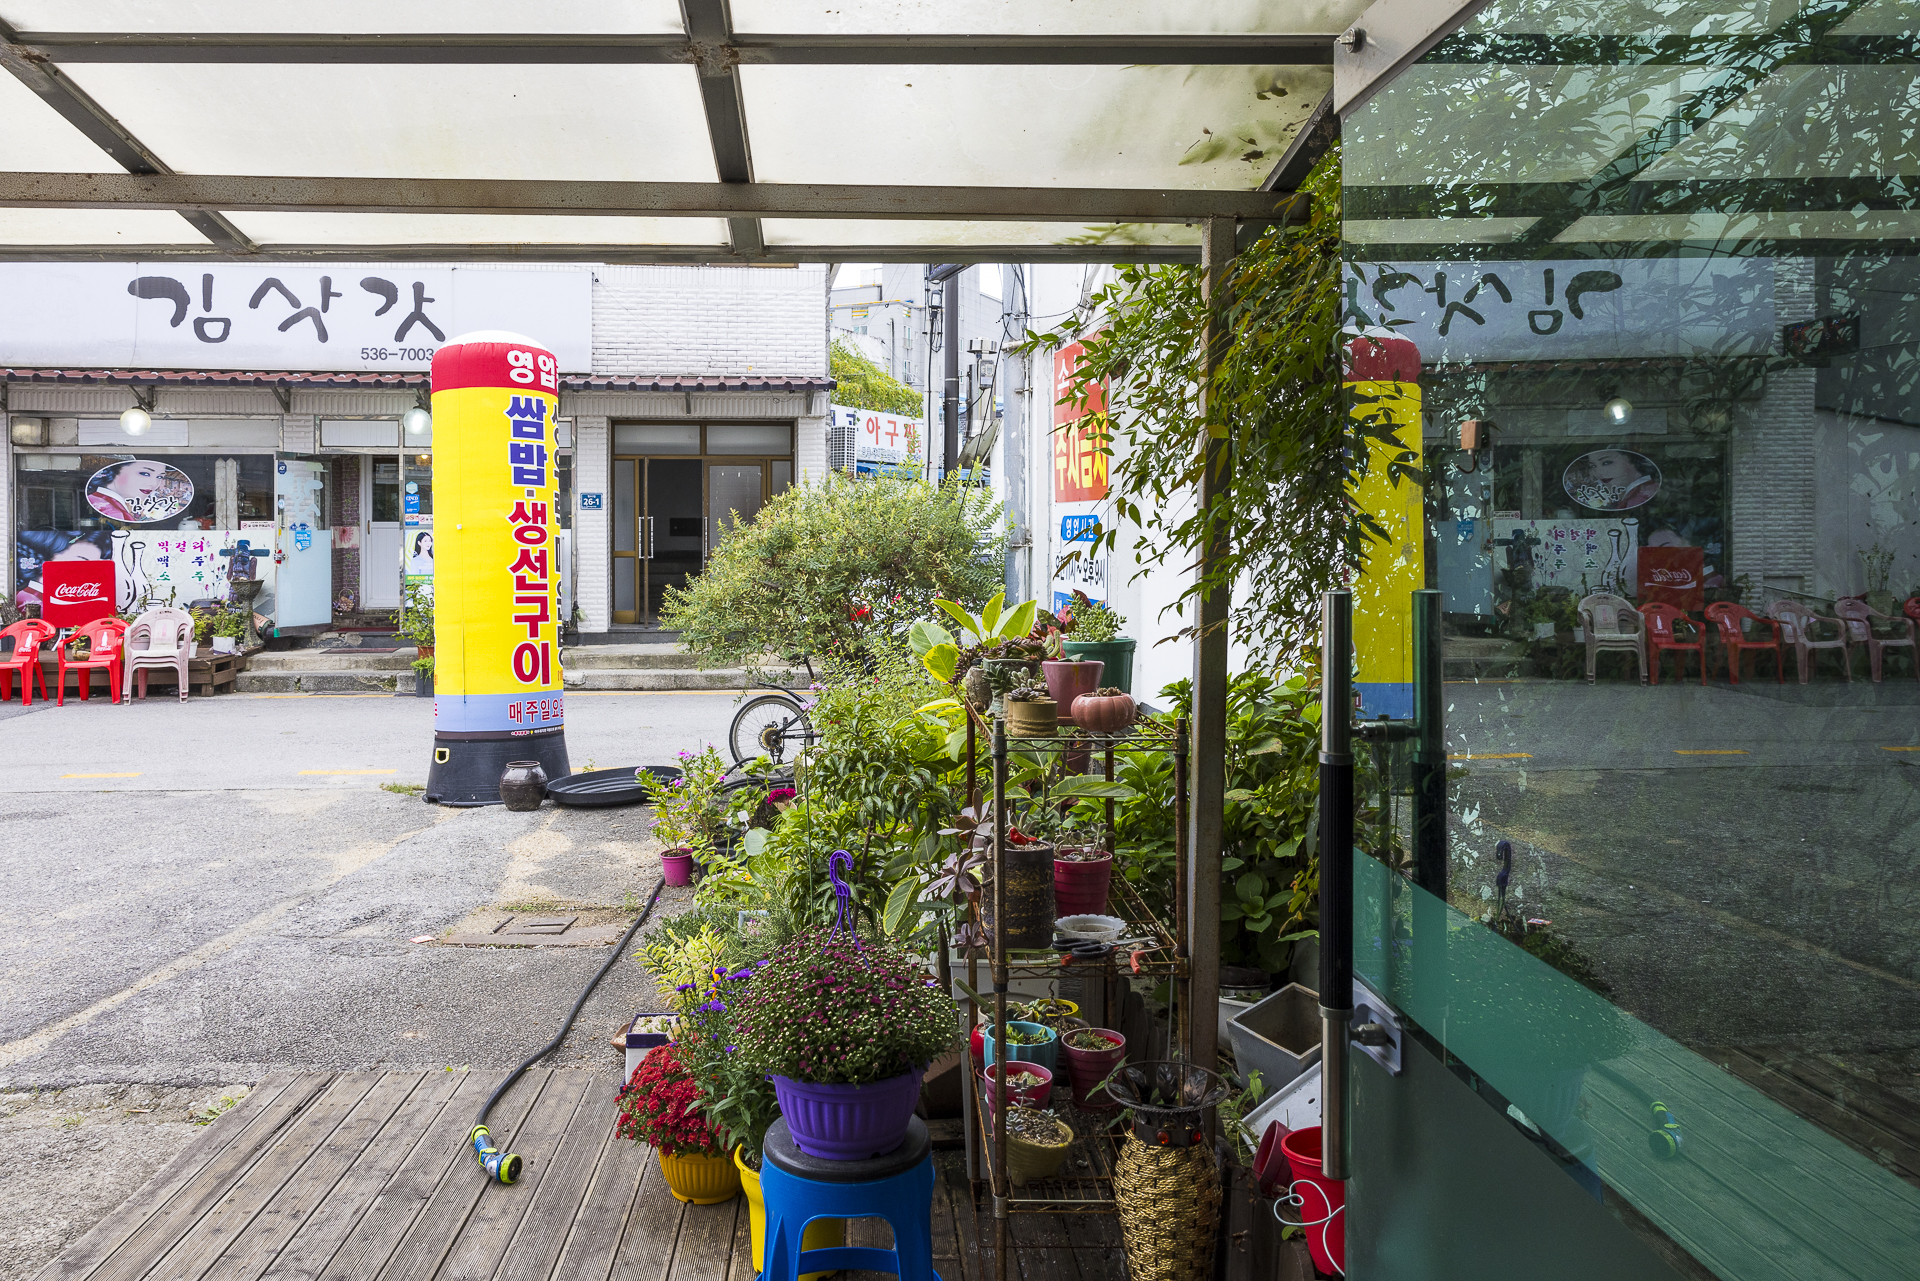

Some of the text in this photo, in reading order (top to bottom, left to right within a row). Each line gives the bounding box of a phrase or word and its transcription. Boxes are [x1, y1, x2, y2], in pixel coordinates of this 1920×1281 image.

[128, 273, 445, 343] 김삿갓
[361, 347, 434, 361] 536-7003
[507, 350, 558, 391] 영업
[125, 496, 178, 513] 김삿갓
[583, 497, 600, 506] 26-1
[158, 540, 204, 553] 막걸리
[157, 571, 204, 582] 소주
[55, 583, 101, 597] Coca-Cola
